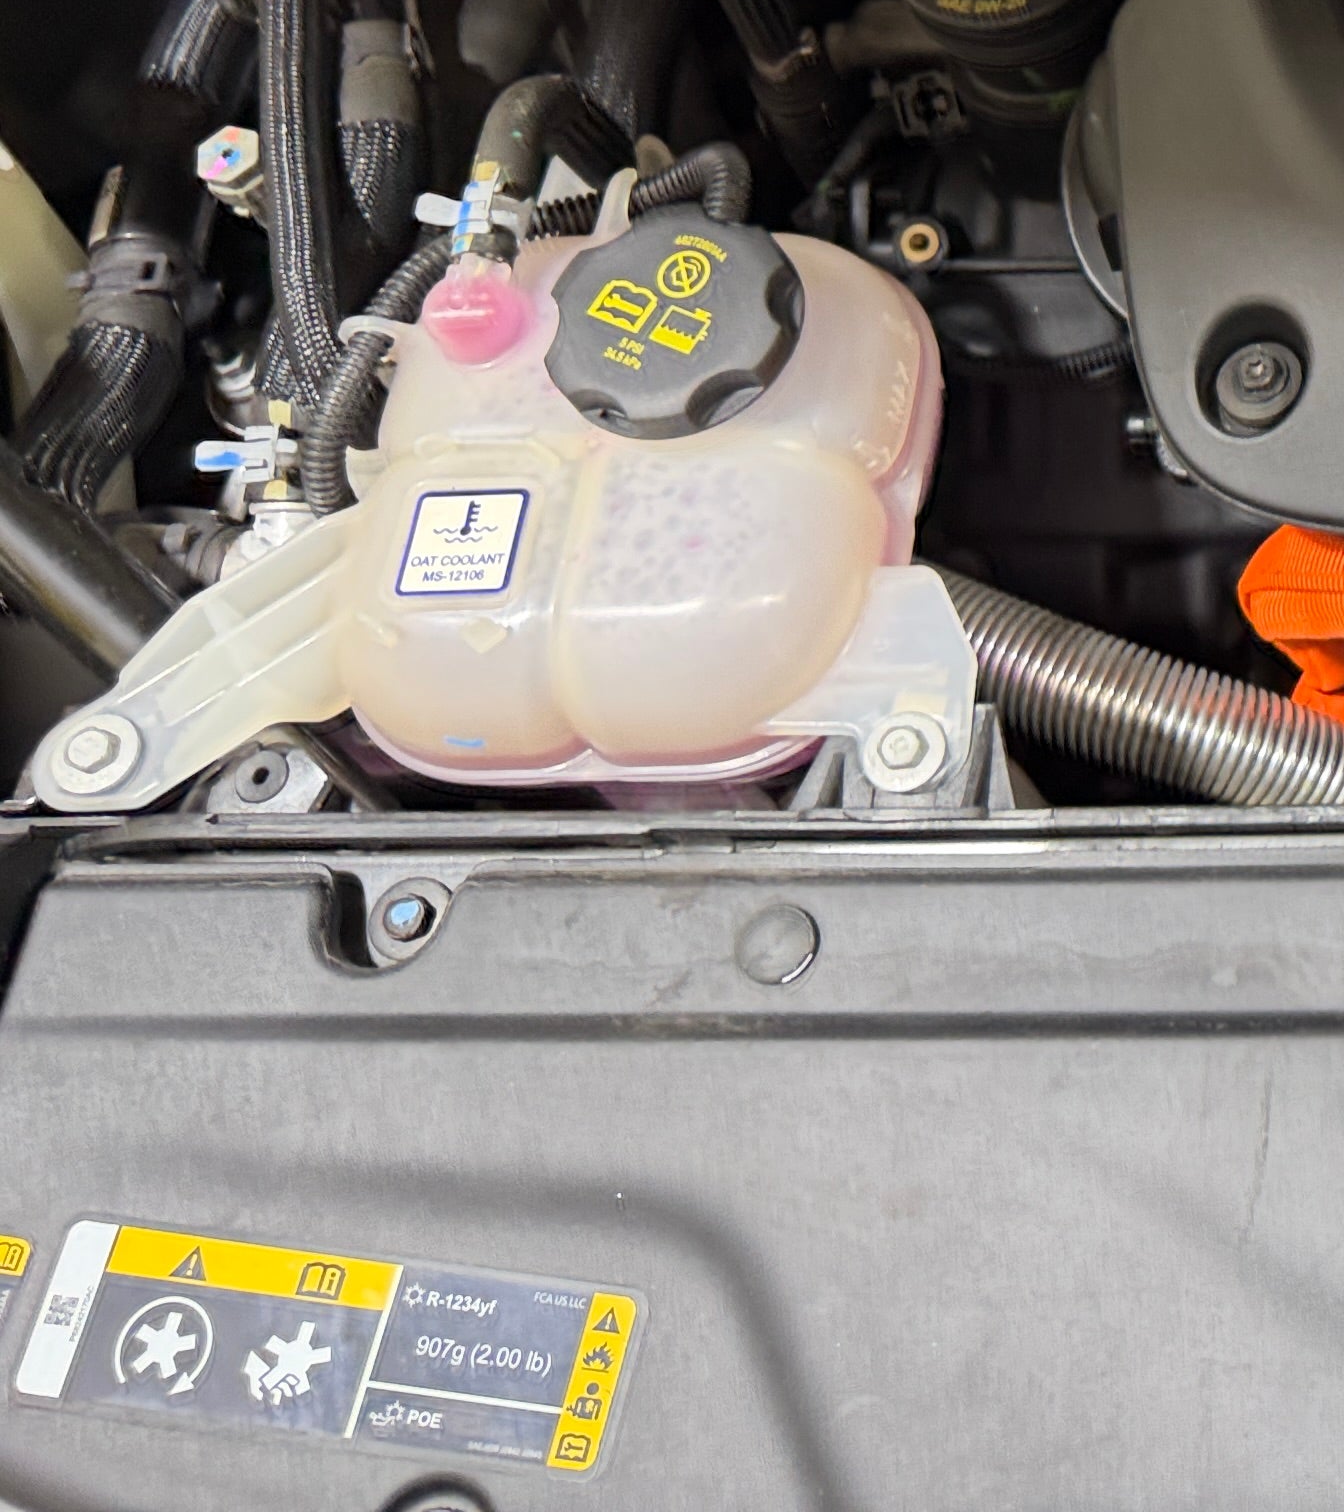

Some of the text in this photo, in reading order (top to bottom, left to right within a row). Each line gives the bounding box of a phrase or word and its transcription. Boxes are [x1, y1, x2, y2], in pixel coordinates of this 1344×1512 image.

[626, 340, 645, 355] PSI
[411, 553, 505, 567] OAT COOLANT
[422, 569, 485, 582] MS-12106
[426, 1291, 497, 1317] R-1234yf
[533, 1290, 588, 1310] FCA US LLC
[415, 1335, 553, 1378] 907g (2.00 lb)
[406, 1408, 443, 1429] POE
